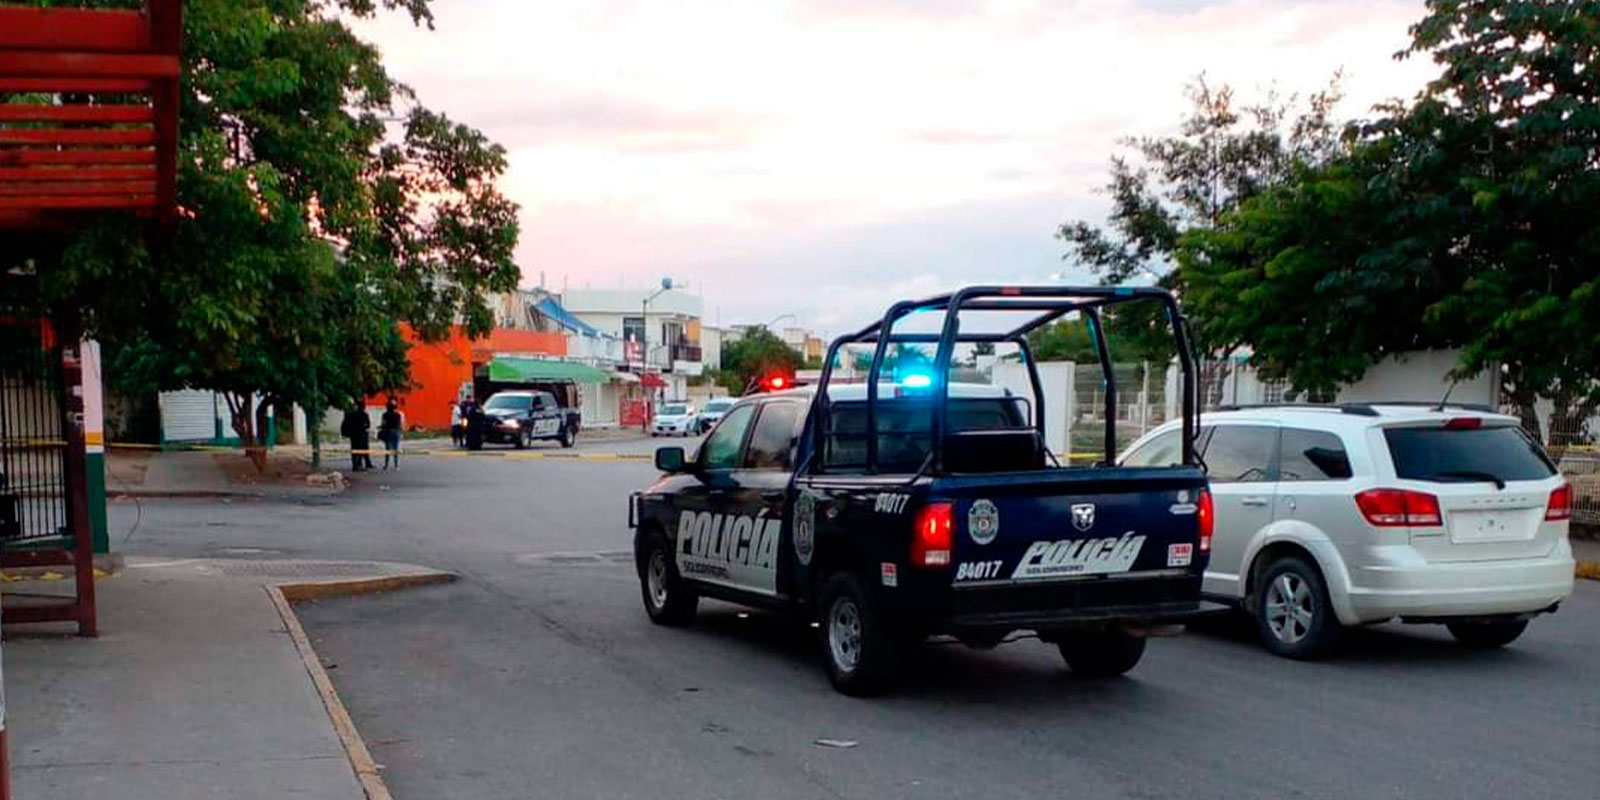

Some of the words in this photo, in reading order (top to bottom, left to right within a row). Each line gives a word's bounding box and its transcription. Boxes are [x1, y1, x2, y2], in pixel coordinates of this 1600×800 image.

[875, 493, 911, 514] 84017
[676, 507, 782, 570] POLICÍA
[1021, 531, 1147, 568] POLICÍA
[956, 560, 1003, 580] 84017
